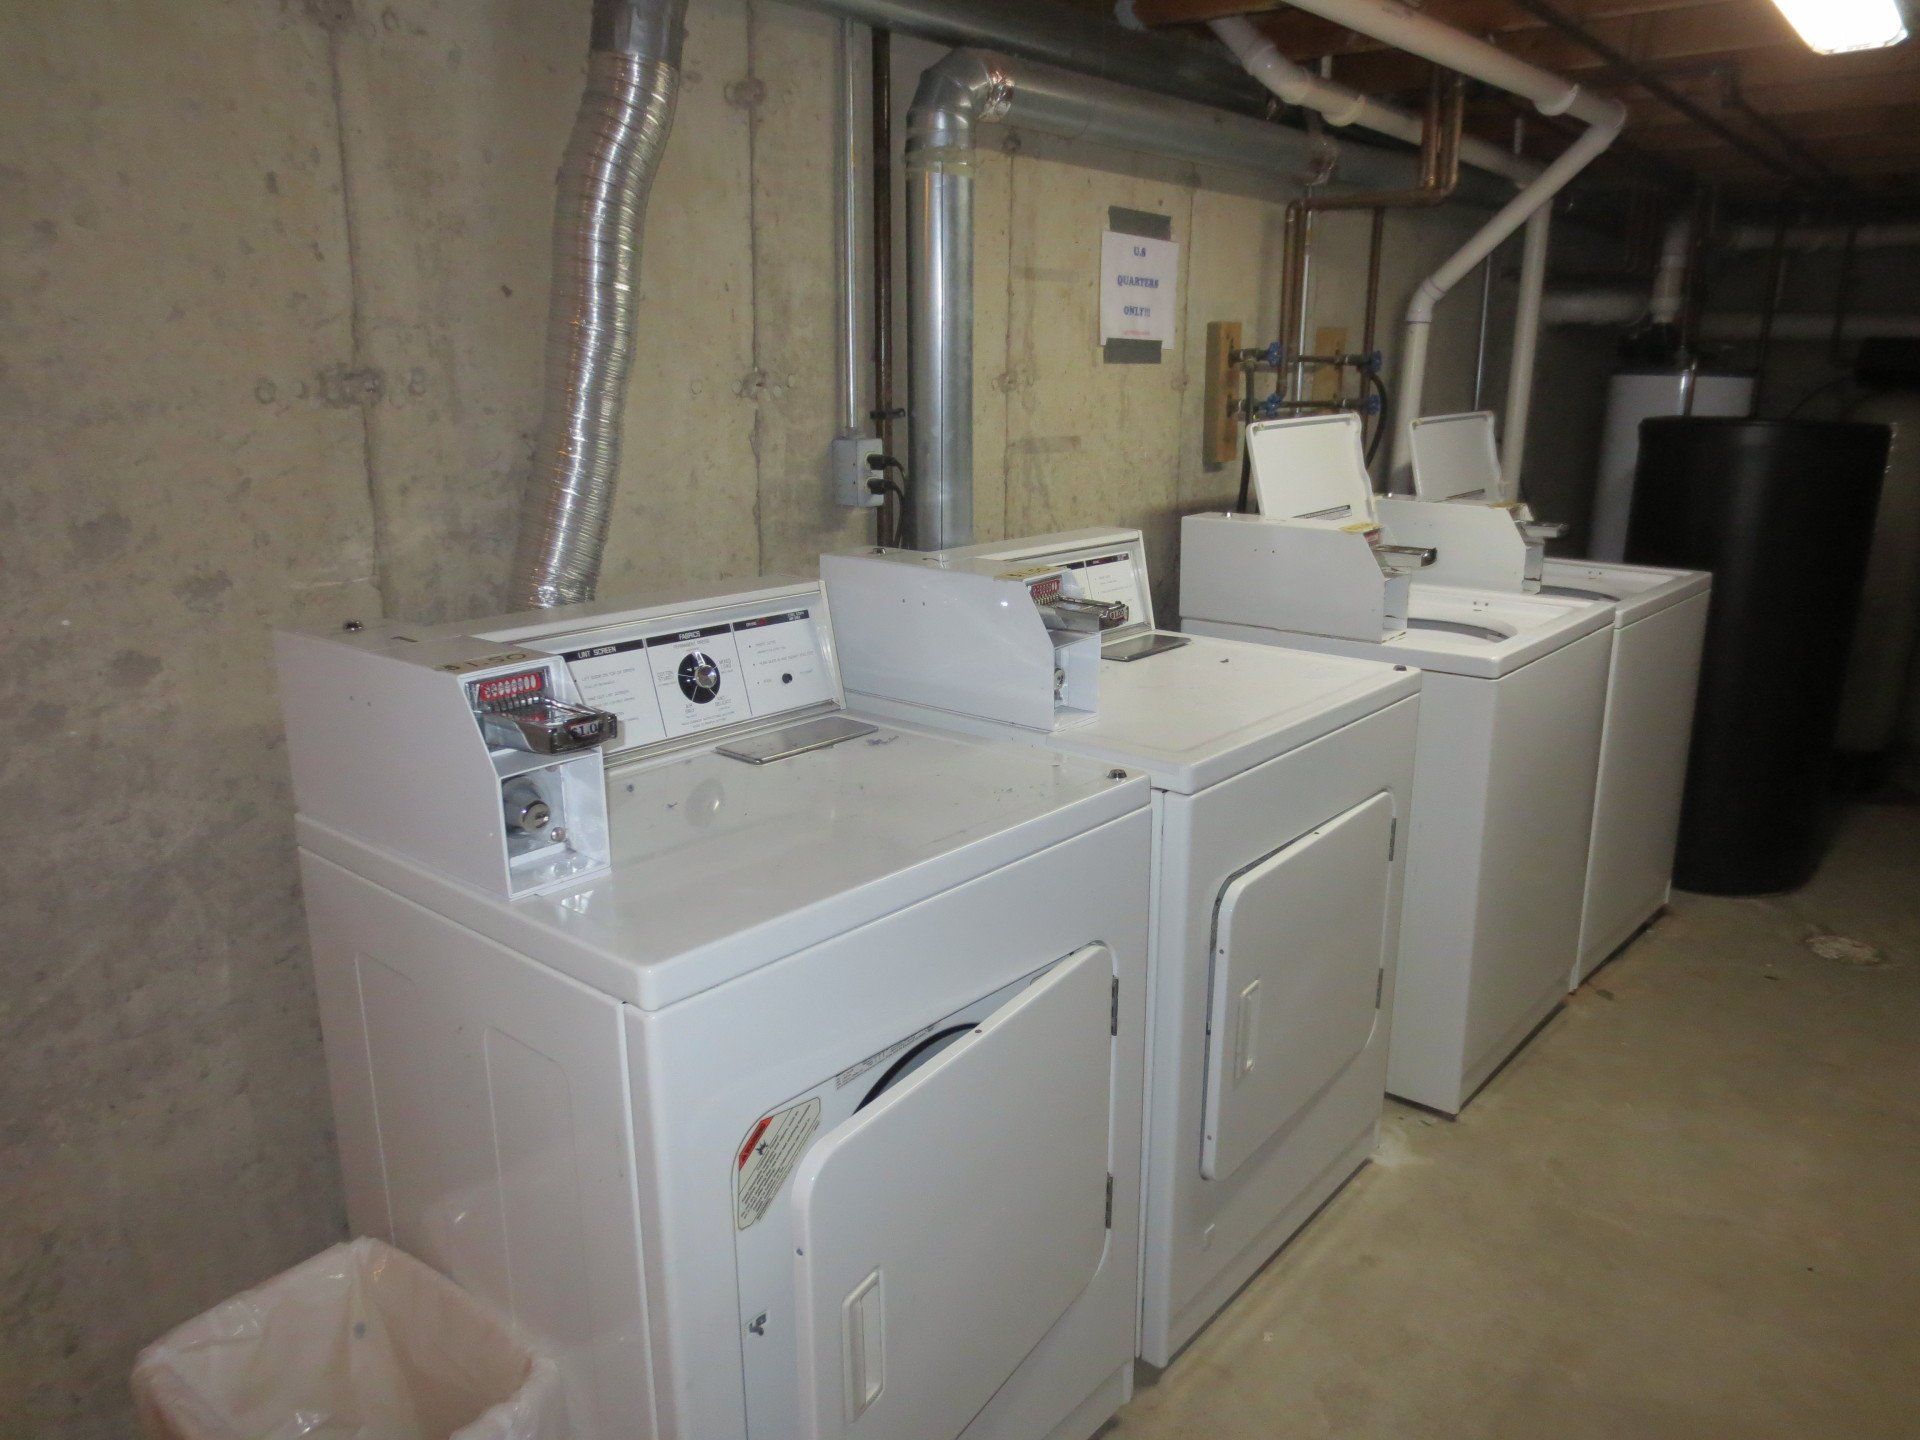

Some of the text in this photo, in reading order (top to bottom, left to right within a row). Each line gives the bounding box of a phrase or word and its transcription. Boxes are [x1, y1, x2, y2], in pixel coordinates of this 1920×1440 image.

[1117, 274, 1159, 289] QUARTERS
[678, 630, 701, 641] FABRICS
[577, 646, 617, 659] LINT SCREEN
